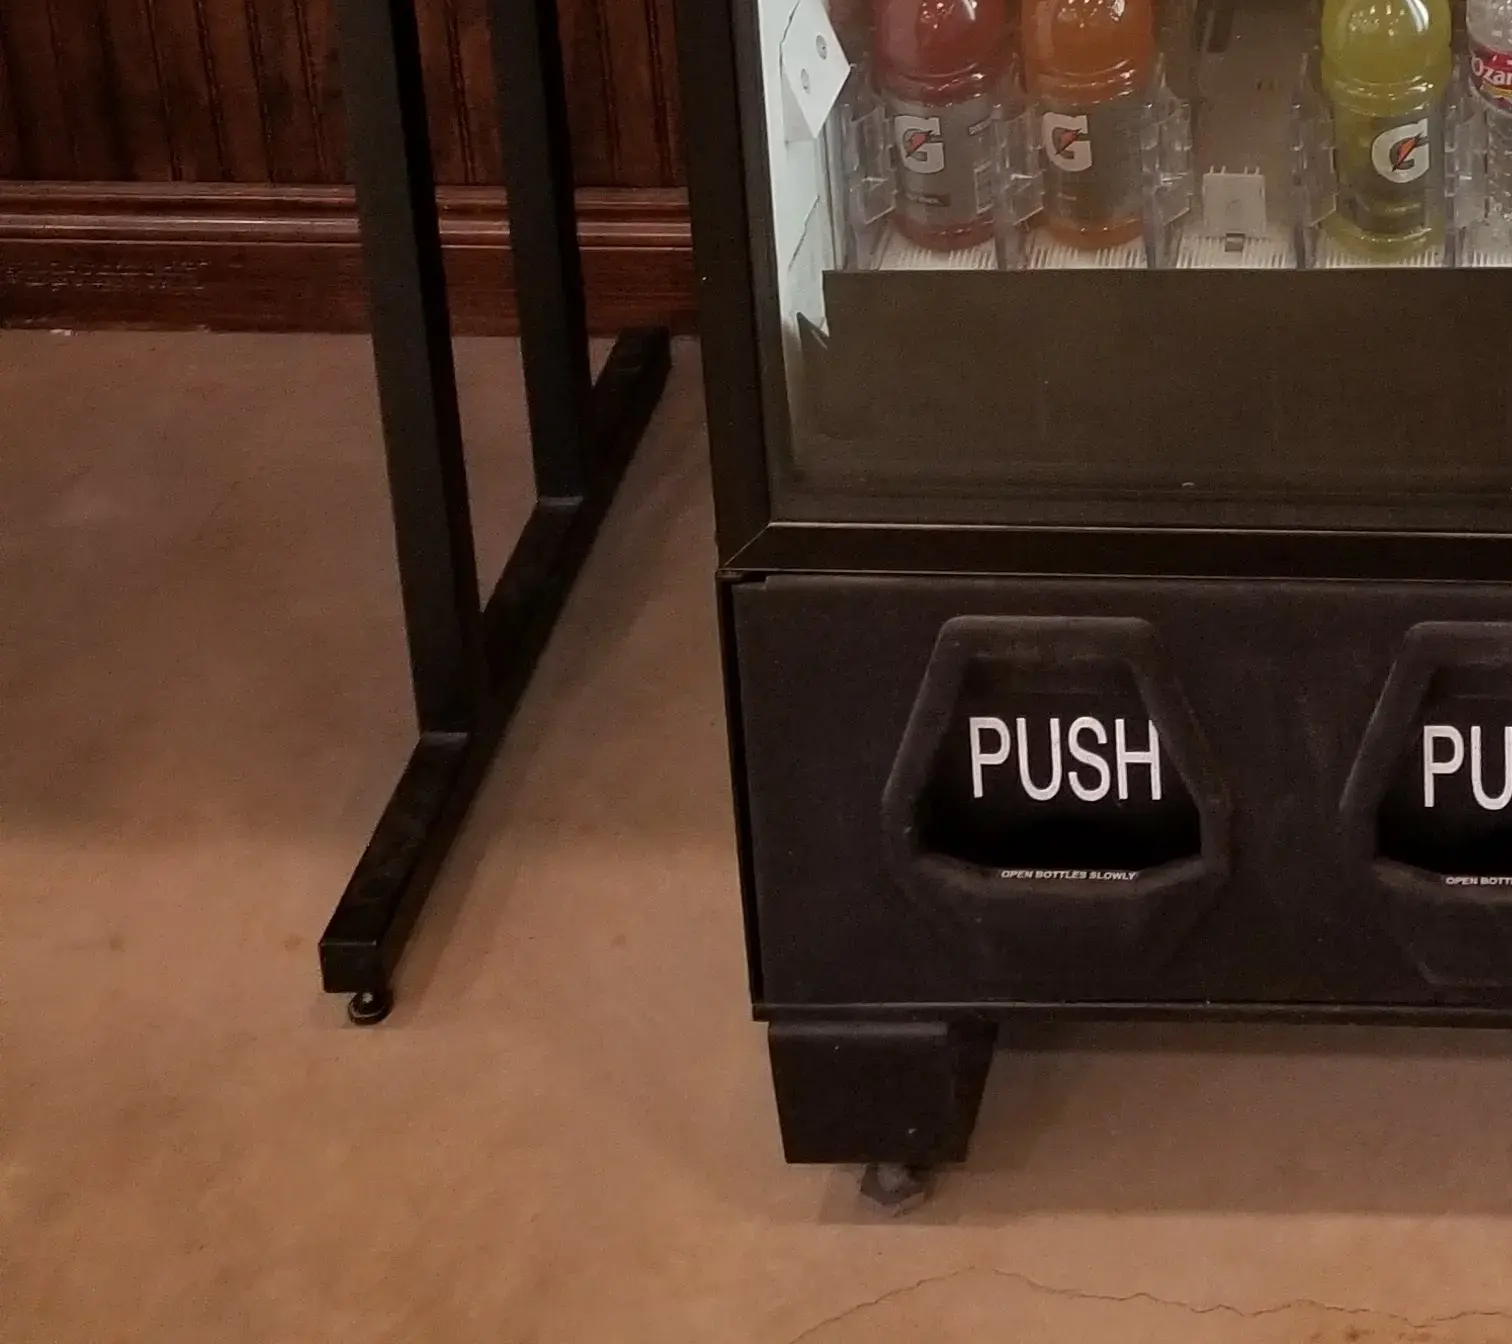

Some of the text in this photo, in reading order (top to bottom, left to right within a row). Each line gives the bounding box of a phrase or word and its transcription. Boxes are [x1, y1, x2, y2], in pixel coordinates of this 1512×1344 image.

[1371, 118, 1430, 184] G
[969, 716, 1162, 802] PUSH
[1035, 871, 1087, 879] BOTTLES
[1089, 872, 1137, 880] SLOWLY
[1445, 877, 1478, 885] OPEN
